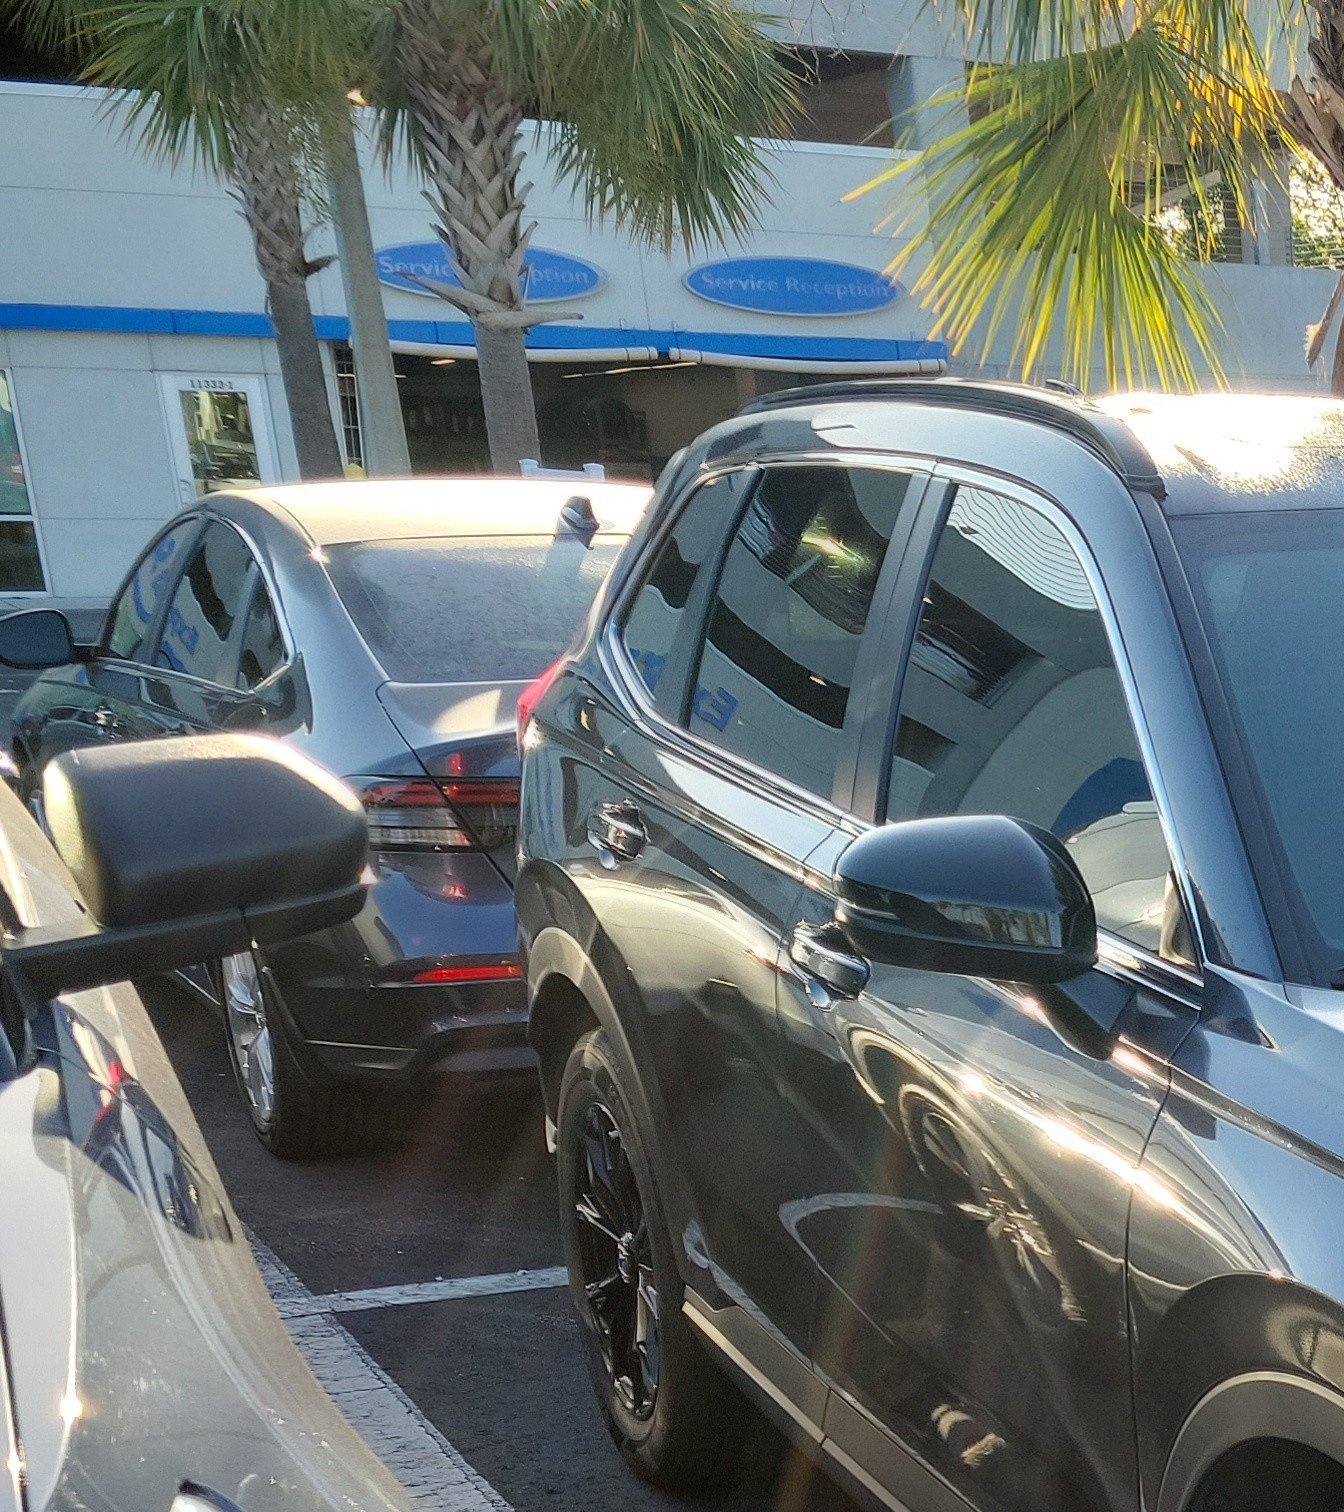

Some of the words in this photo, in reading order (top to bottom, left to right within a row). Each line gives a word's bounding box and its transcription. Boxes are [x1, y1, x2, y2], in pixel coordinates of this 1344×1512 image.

[379, 255, 452, 282] Servic
[700, 271, 779, 293] Service
[785, 275, 889, 300] Reception
